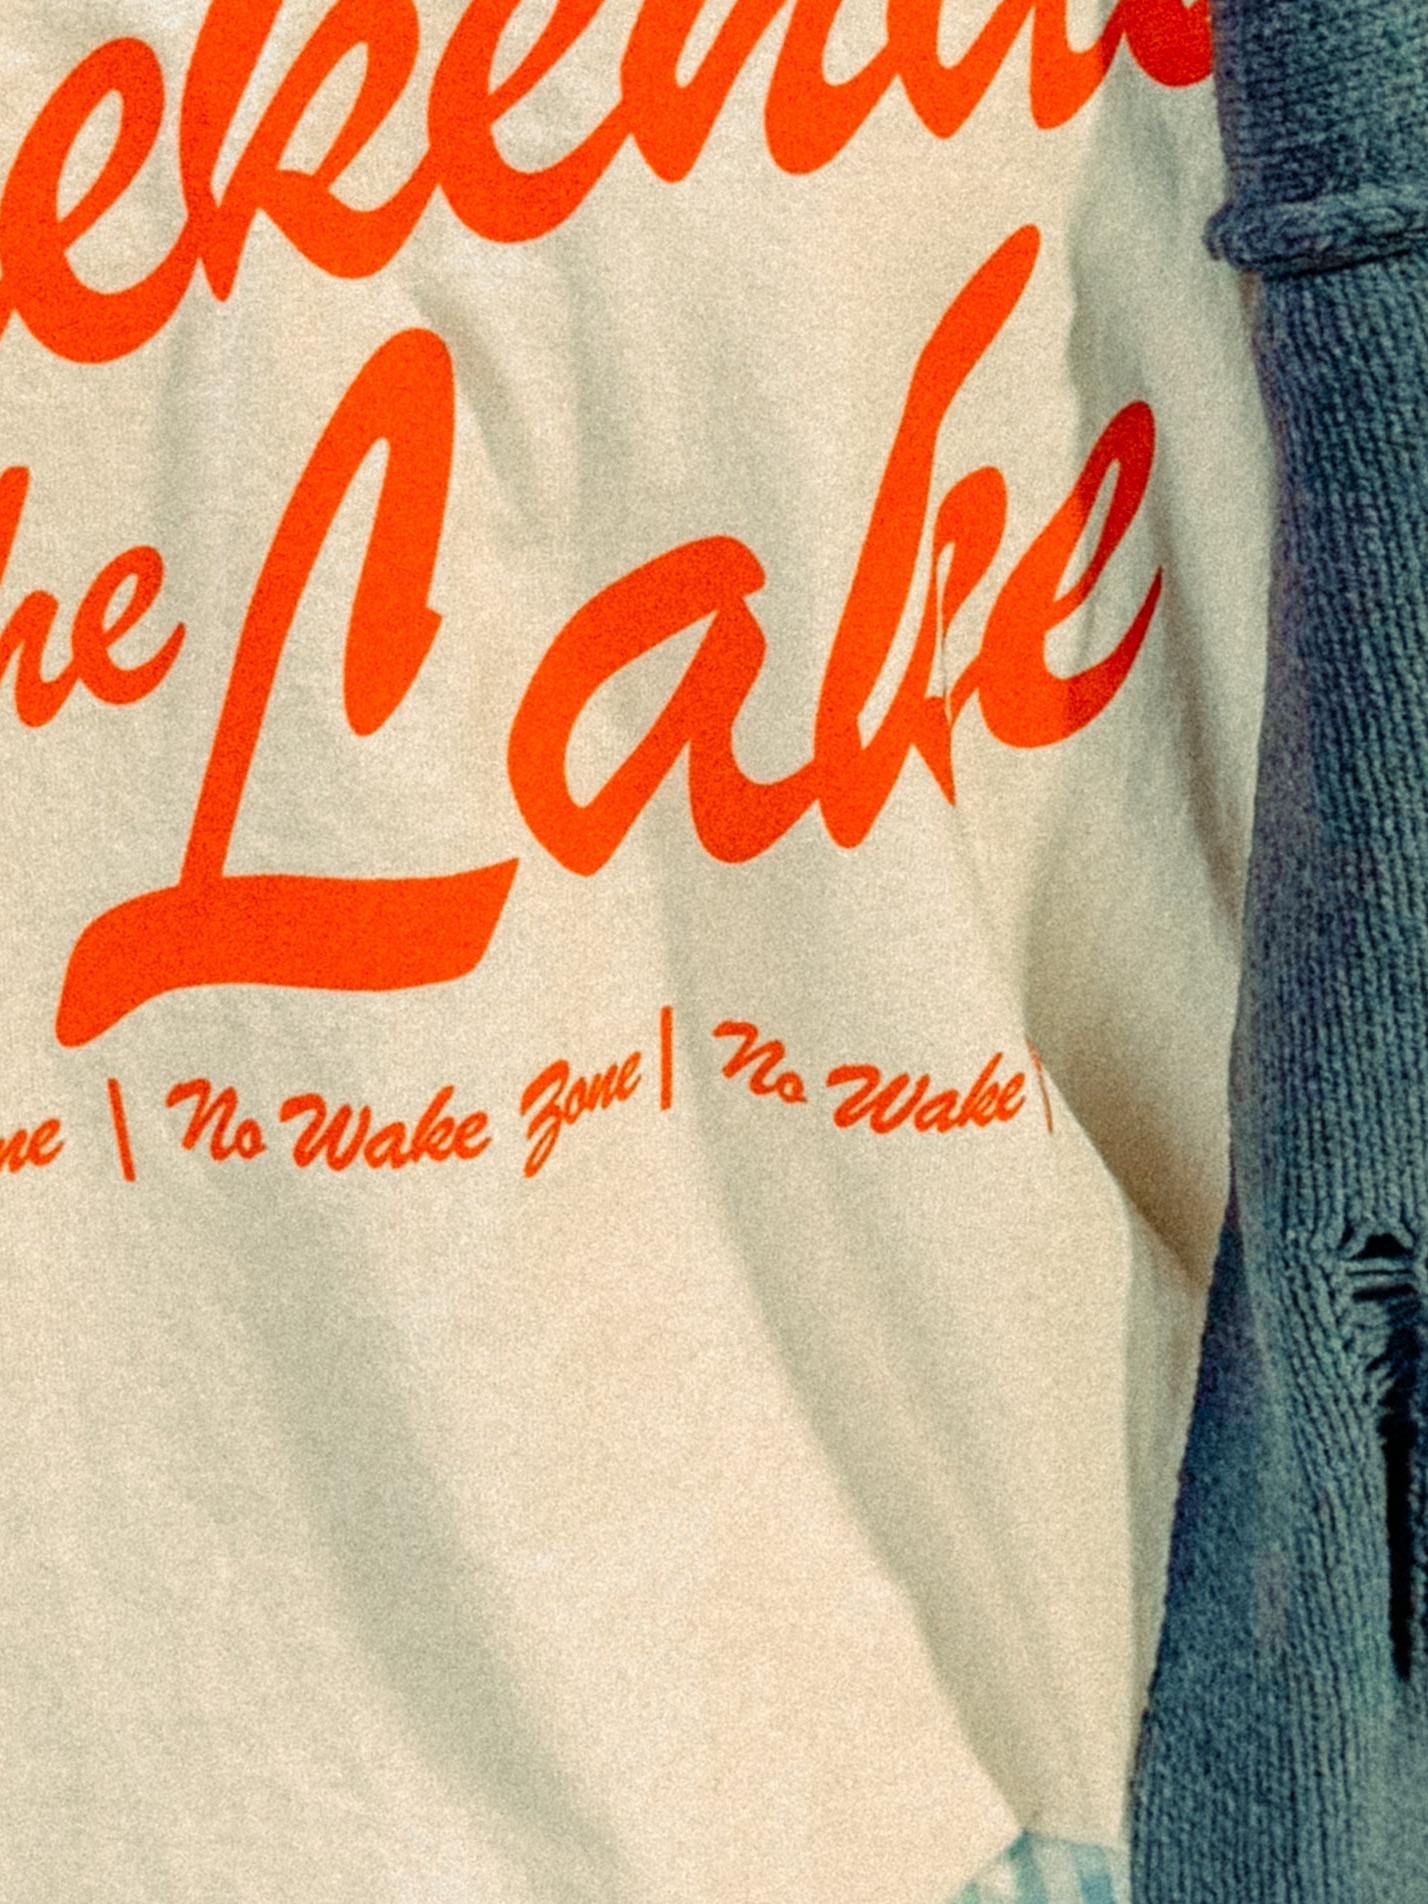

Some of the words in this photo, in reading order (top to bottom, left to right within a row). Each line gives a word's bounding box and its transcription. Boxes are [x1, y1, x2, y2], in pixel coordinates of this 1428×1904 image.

[54, 223, 1164, 1049] Lake
[164, 1077, 268, 1162] No
[278, 1085, 492, 1172] Wake
[519, 1050, 643, 1179] Zone
[711, 1019, 809, 1105] No
[824, 1051, 1026, 1135] Wake
